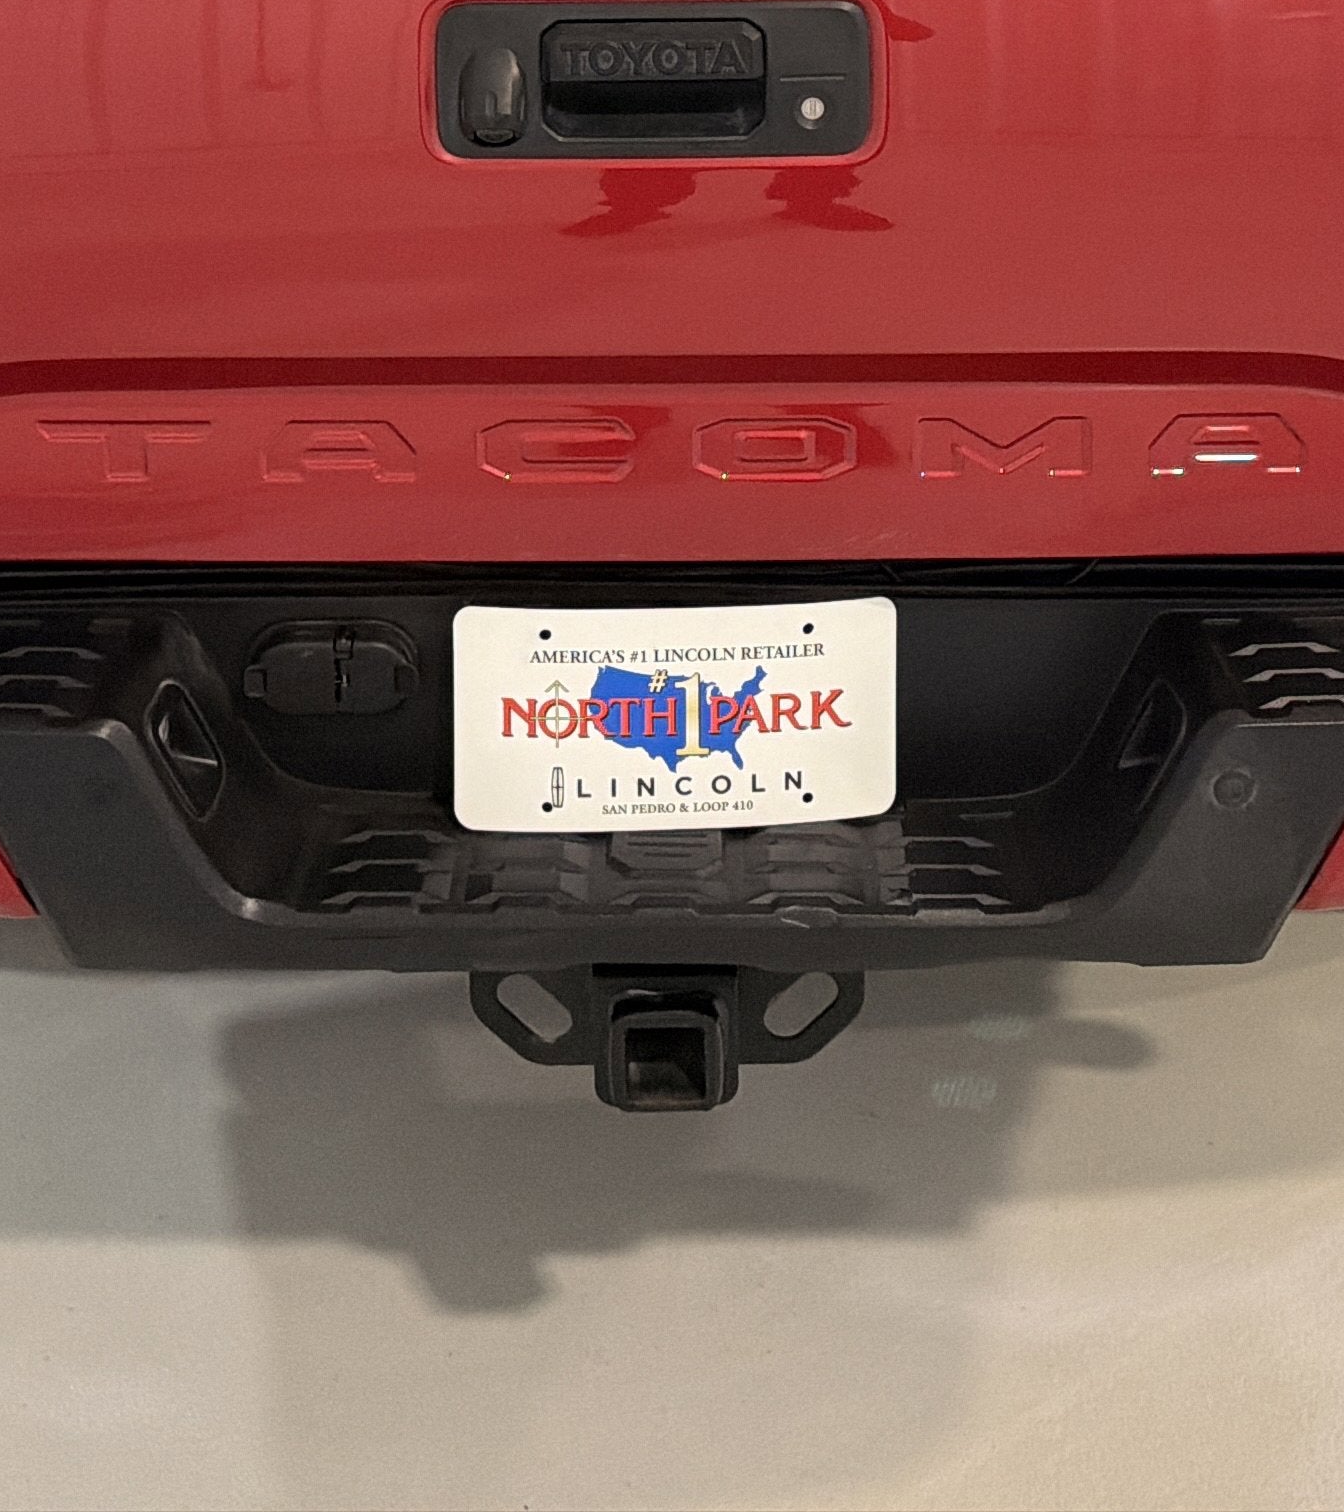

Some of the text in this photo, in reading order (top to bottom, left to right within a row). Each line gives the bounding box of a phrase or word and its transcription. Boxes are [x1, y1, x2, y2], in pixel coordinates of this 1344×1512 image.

[560, 40, 749, 76] TOYOTA
[36, 412, 1308, 482] TACOMA
[529, 642, 825, 664] AMERICA'S #1 LINCOLN RETAILER
[501, 688, 853, 740] NORTH PARK
[576, 770, 803, 799] LINCOLN
[601, 800, 754, 815] SAN PEDRO & LOOP 410
